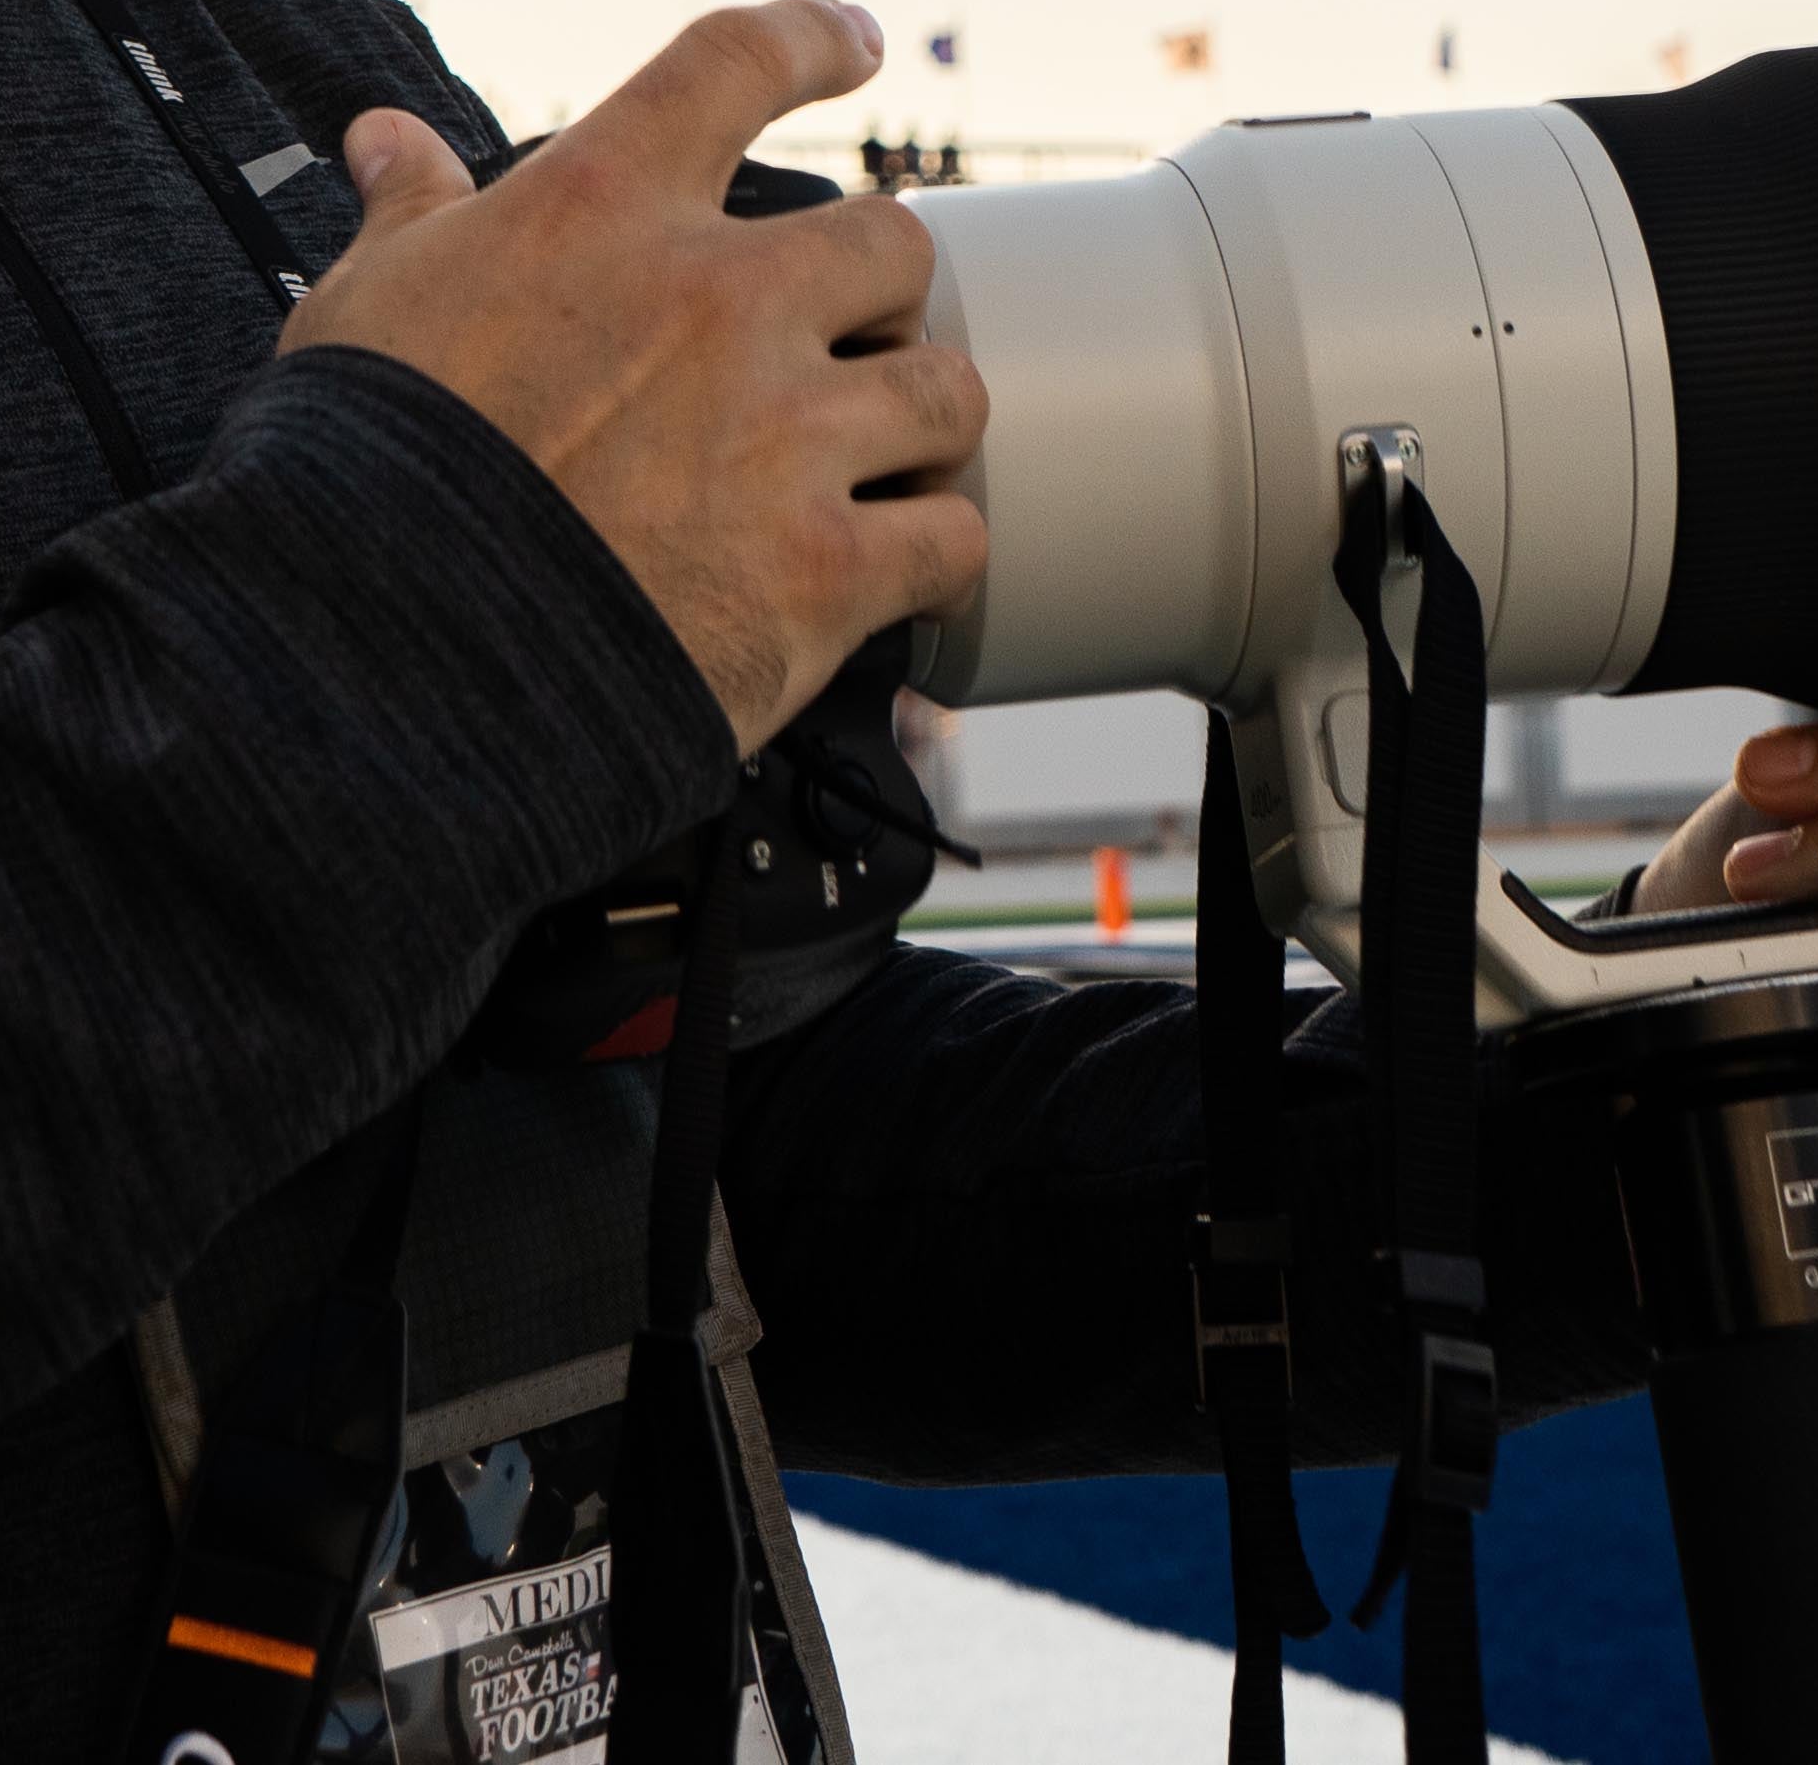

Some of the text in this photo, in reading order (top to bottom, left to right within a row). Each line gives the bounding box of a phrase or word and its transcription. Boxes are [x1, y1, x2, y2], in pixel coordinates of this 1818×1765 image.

[480, 1561, 608, 1636] MEDI
[469, 1651, 583, 1718] TEXAS
[478, 1672, 619, 1762] FOOTBA
